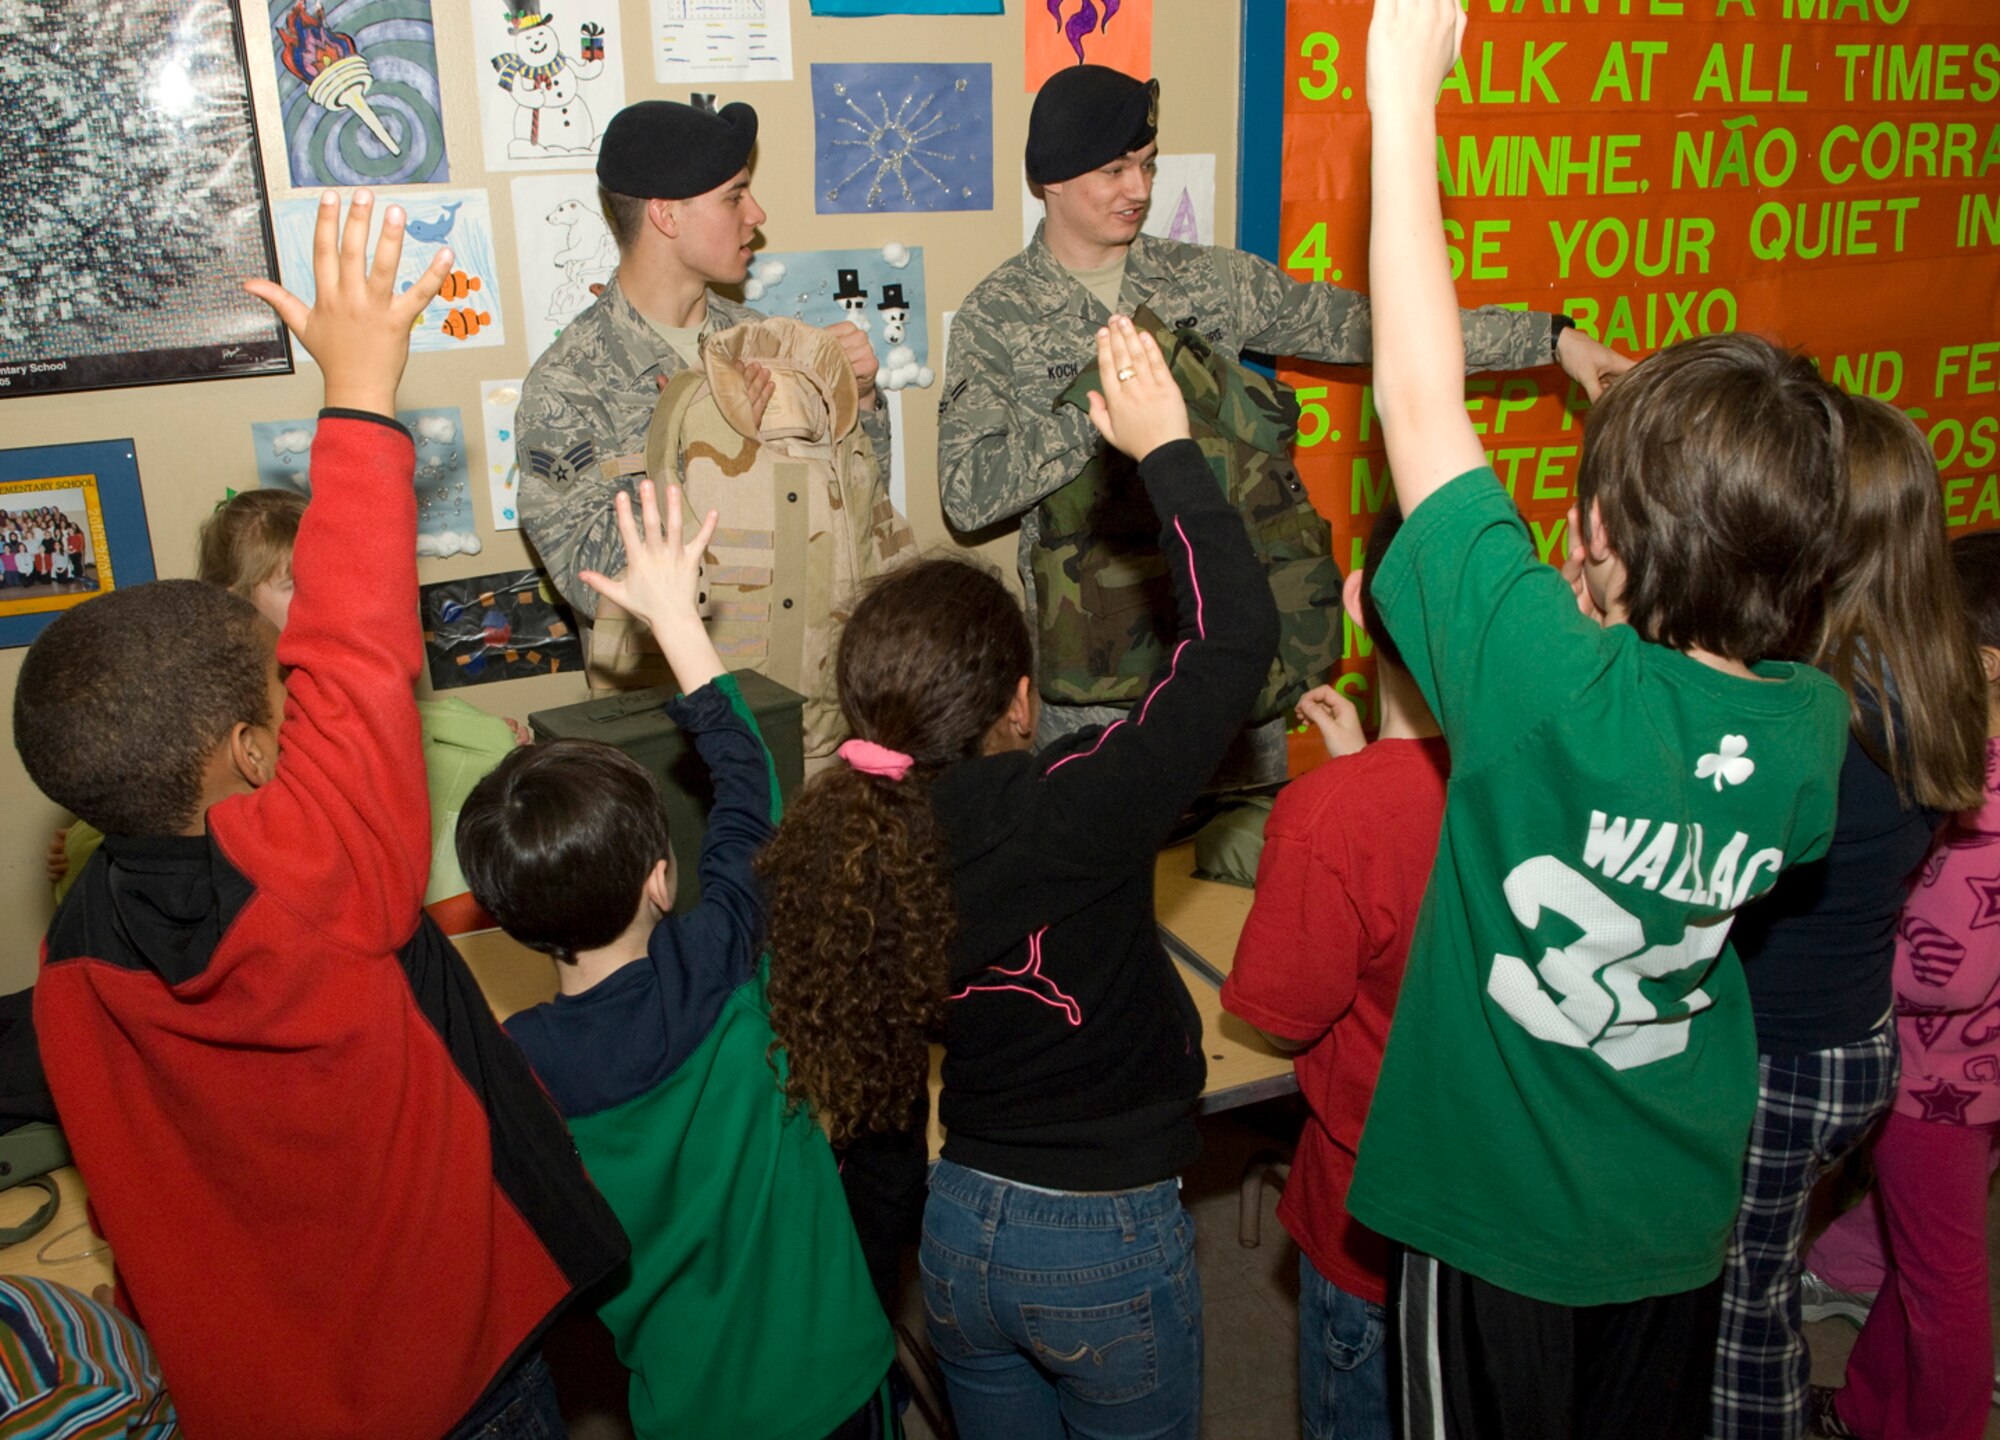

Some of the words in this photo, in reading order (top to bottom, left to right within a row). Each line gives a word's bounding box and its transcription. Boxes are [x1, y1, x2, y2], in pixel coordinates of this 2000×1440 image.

[1299, 32, 1353, 101] 3.
[1435, 41, 1568, 104] ALK
[1590, 41, 1669, 102] AT
[1693, 43, 1808, 103] ALL
[1835, 43, 2000, 102] TIMES
[1671, 115, 1798, 189] NÃO
[1287, 222, 1343, 282] 4.
[1443, 218, 1511, 281] SE
[1549, 216, 1716, 278] YOUR
[1750, 197, 1921, 262] QUIET
[30, 361, 68, 373] School
[1047, 363, 1078, 380] KOCH
[1296, 386, 1341, 448] 5.
[1811, 351, 1903, 402] ND
[1935, 341, 2000, 399] FE
[56, 479, 95, 489] SCHOOL
